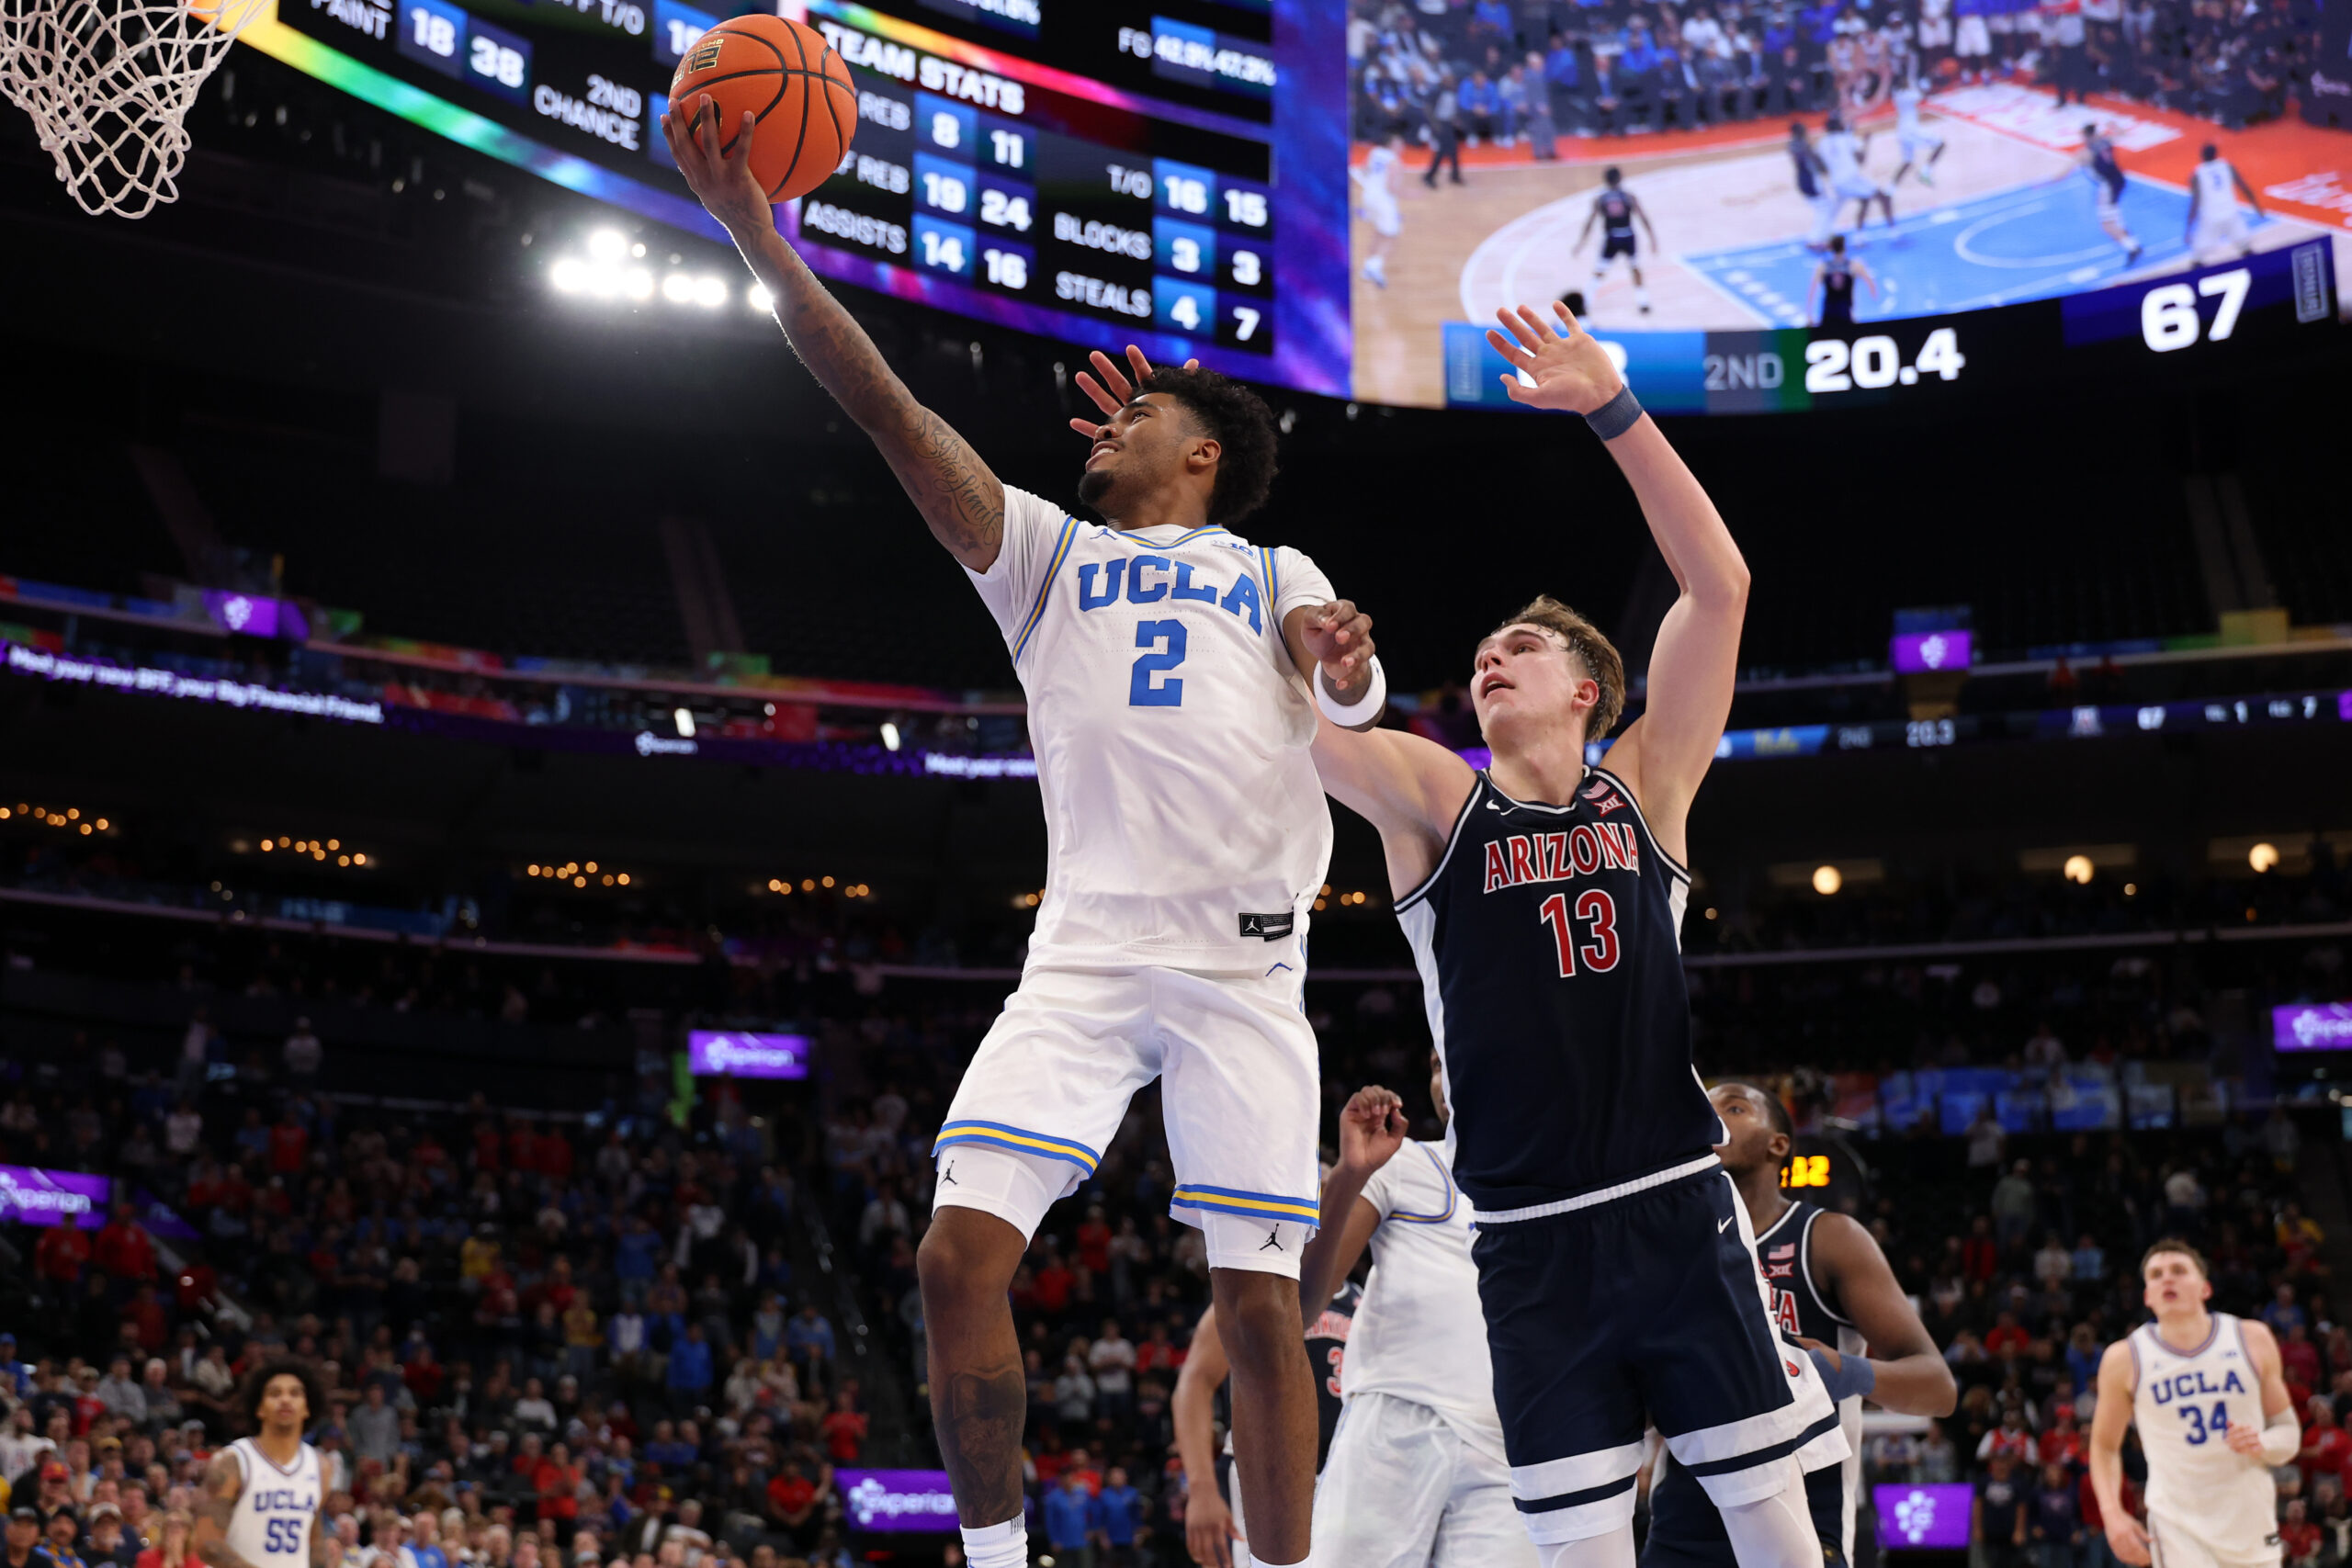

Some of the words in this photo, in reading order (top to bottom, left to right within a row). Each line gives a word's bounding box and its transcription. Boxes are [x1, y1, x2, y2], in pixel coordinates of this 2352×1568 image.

[311, 0, 392, 40] AINT
[1118, 27, 1152, 58] FG
[470, 36, 524, 88] 38
[819, 22, 916, 82] TEAM
[920, 55, 1024, 115] STATS
[534, 85, 640, 151] CHANCE
[587, 73, 641, 118] 2ND
[858, 91, 910, 130] REB
[933, 112, 959, 148] 8
[990, 130, 1023, 168] 11
[857, 154, 910, 194] REB
[923, 173, 966, 212] 19
[980, 189, 1033, 231] 24
[1105, 164, 1152, 198] T/O
[1224, 189, 1267, 227] 15
[804, 200, 907, 254] ASSISTS
[922, 231, 965, 272] 14
[984, 249, 1027, 289] 16
[1054, 211, 1152, 260] BLOCKS
[1171, 237, 1200, 272] 3
[1233, 250, 1261, 286] 3
[1056, 270, 1152, 318] STEALS
[1170, 296, 1200, 330] 4
[1233, 306, 1261, 341] 7
[2141, 267, 2251, 353] 67
[1704, 354, 1782, 390] 2ND
[1805, 327, 1965, 393] 20.4
[1078, 555, 1262, 637] UCLA
[1129, 619, 1188, 707] 2
[1906, 719, 1956, 748] 20.3
[1594, 792, 1625, 817] XII
[1484, 822, 1640, 894] ARIZONA
[1540, 888, 1620, 977] 13
[2150, 1371, 2245, 1405] UCLA
[2178, 1401, 2228, 1447] 34
[254, 1489, 315, 1513] UCLA
[265, 1517, 301, 1554] 55
